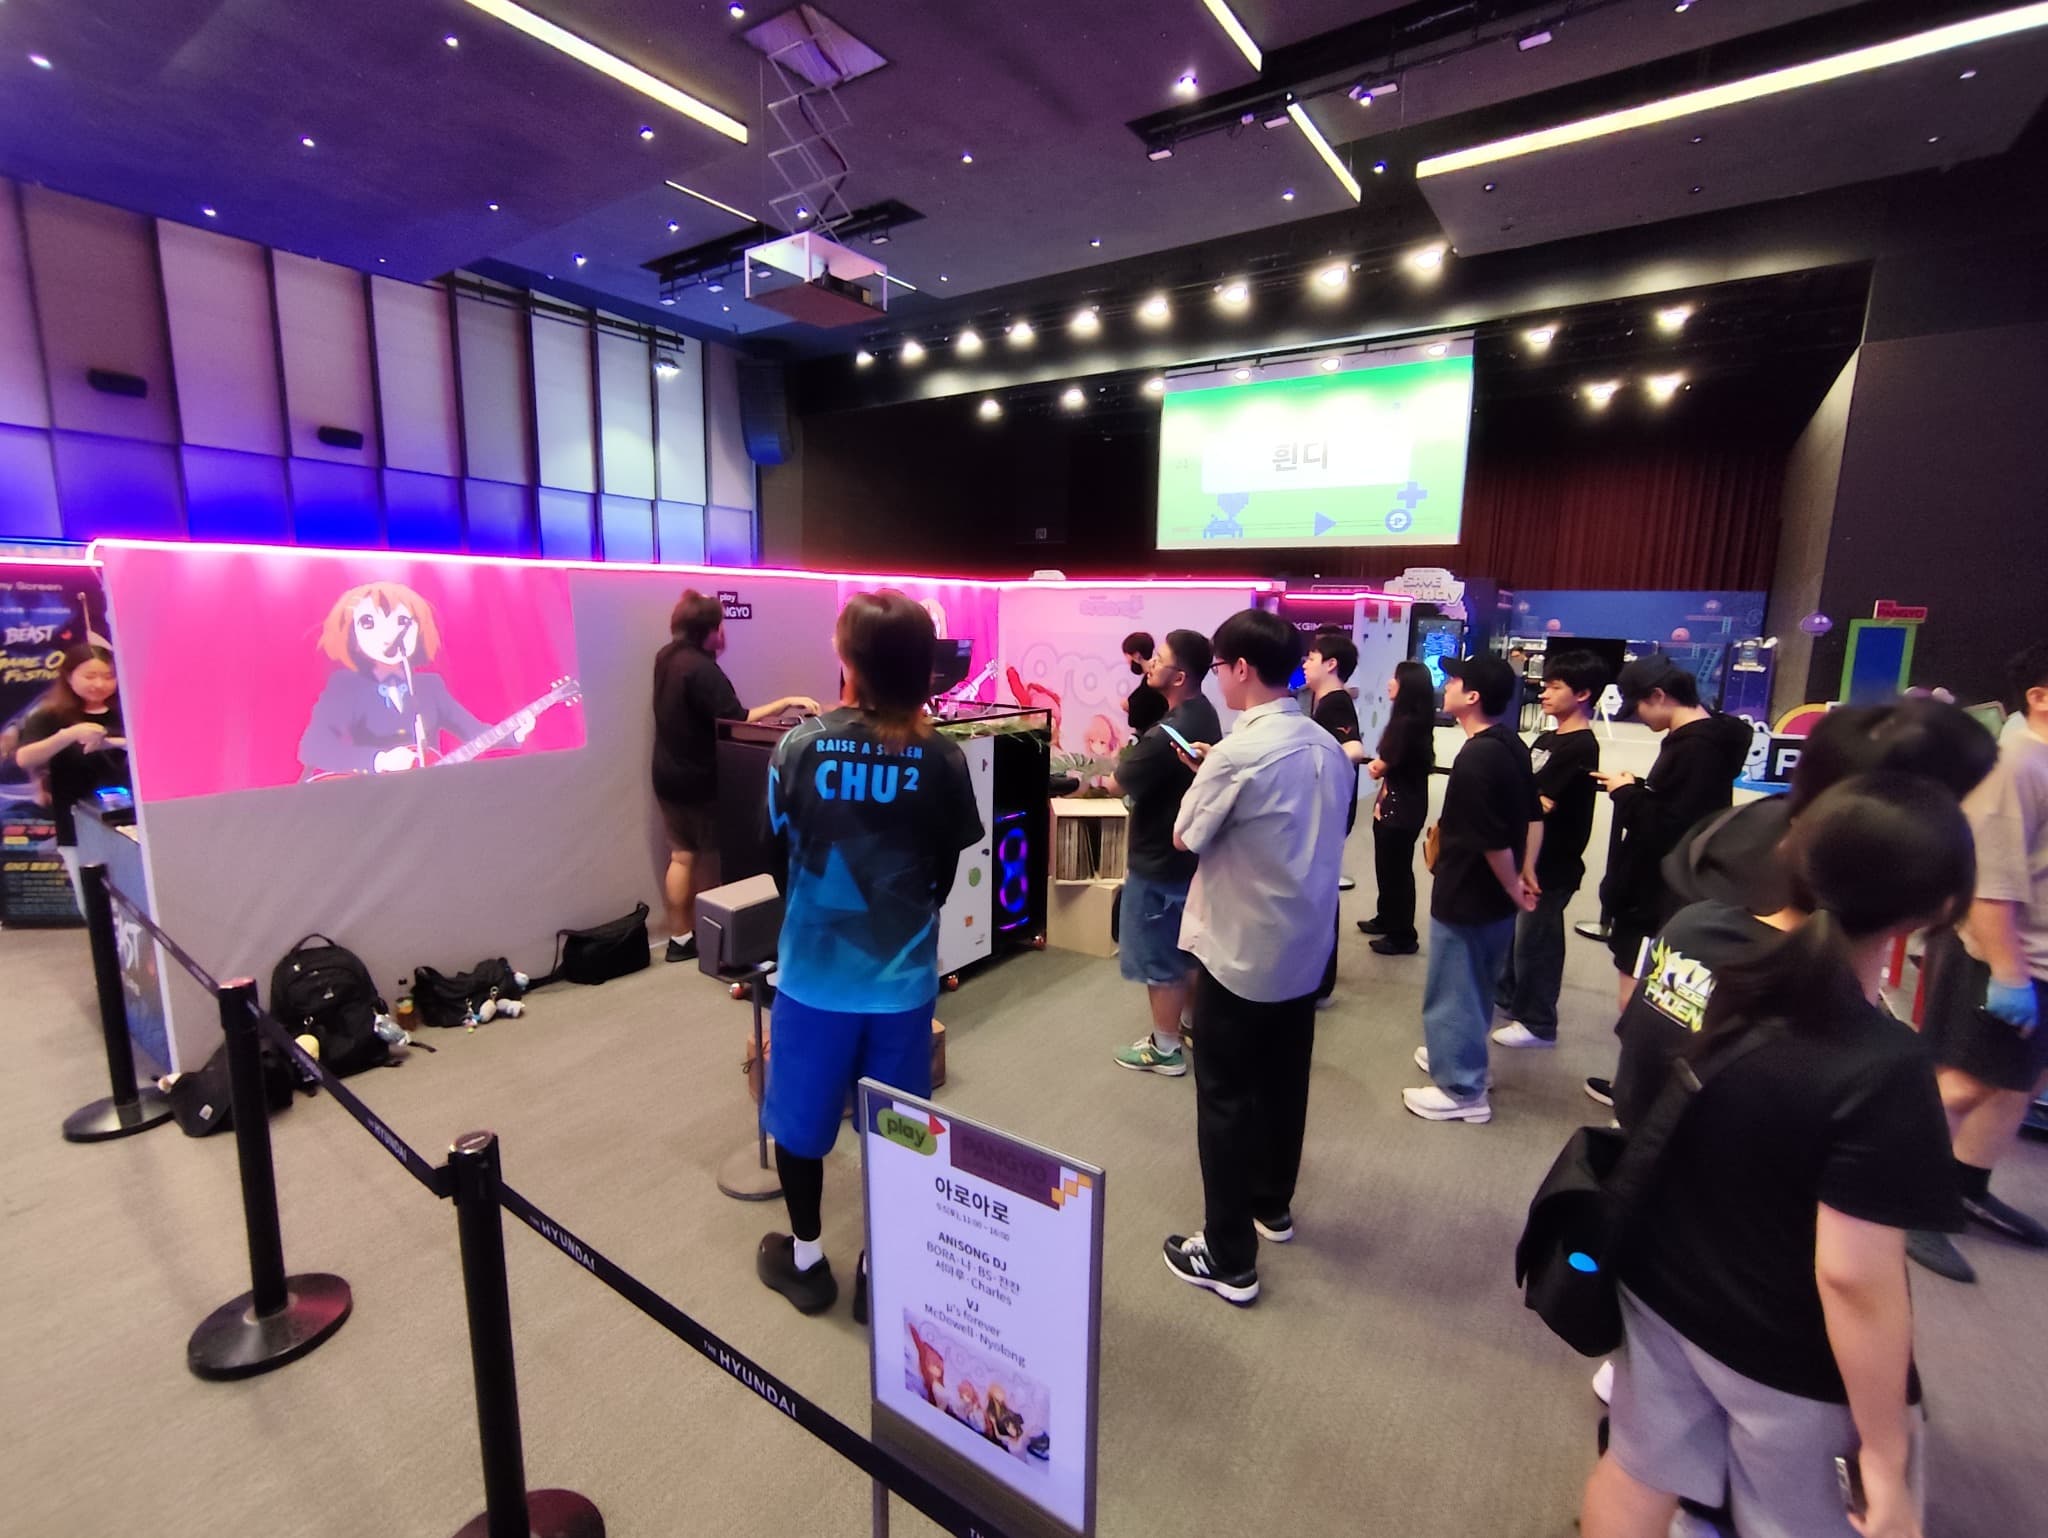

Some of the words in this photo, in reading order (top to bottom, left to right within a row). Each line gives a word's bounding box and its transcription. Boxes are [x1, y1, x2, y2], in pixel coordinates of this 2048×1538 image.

[4, 624, 59, 646] BEAST
[1293, 622, 1323, 632] XGIM
[816, 738, 856, 754] RAISE
[861, 742, 871, 755] A
[886, 1117, 927, 1148] play
[935, 1177, 1010, 1225] 아로아로
[541, 1220, 595, 1272] HYUNDAI
[938, 1232, 990, 1264] ANISONG
[993, 1257, 1007, 1272] DJ
[966, 1297, 979, 1313] VJ
[963, 1310, 1000, 1337] forever
[719, 1349, 798, 1419] HYUNDAI
